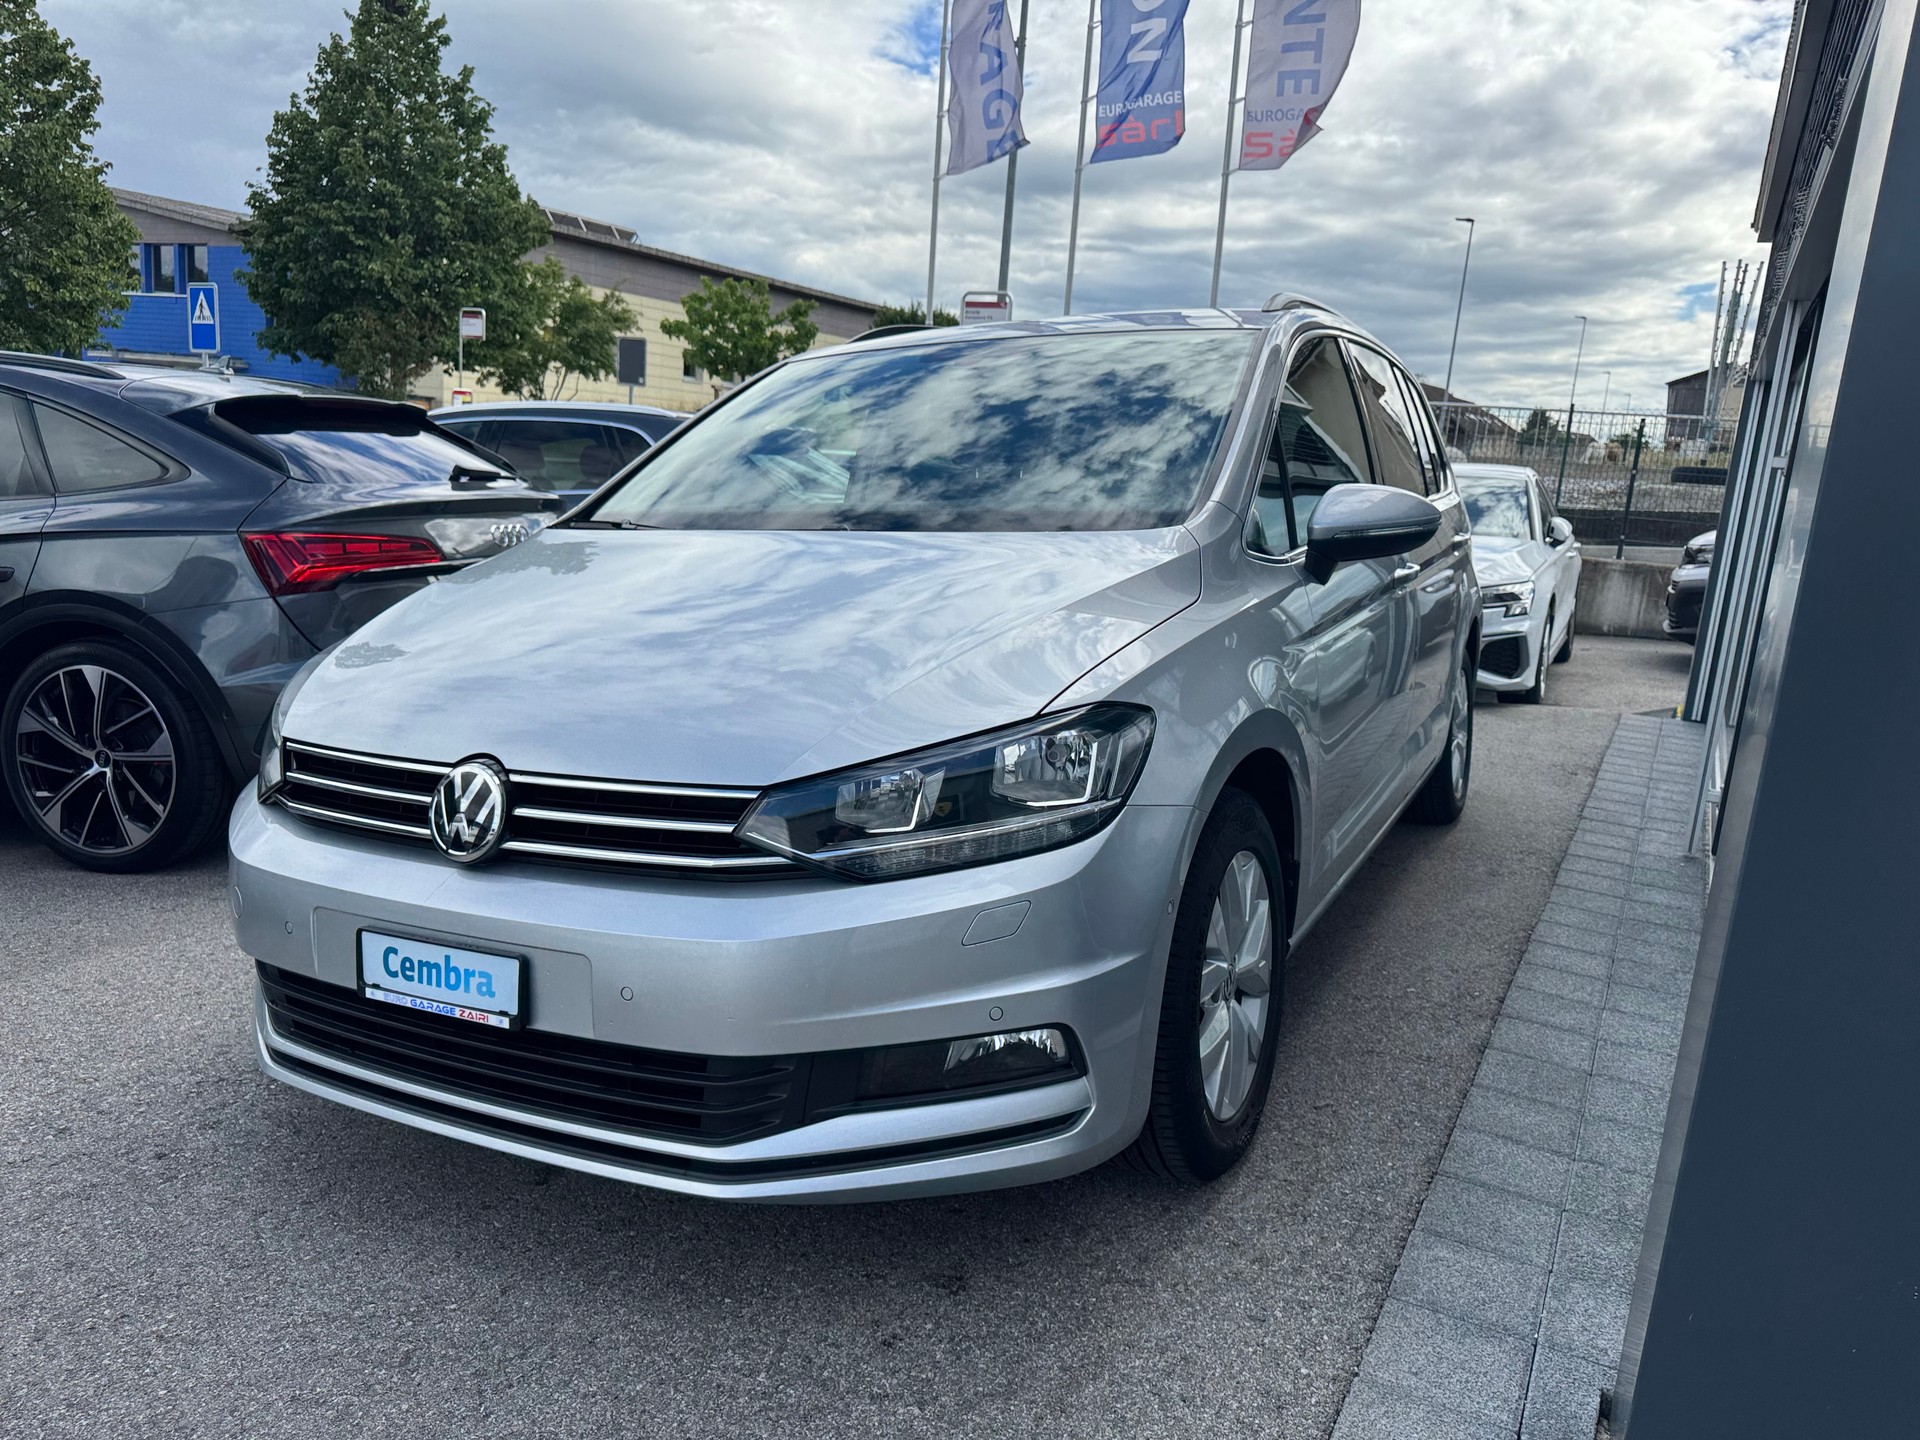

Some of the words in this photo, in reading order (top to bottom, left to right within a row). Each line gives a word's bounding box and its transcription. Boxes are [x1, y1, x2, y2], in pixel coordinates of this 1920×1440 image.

[383, 946, 496, 998] Cembra
[383, 992, 409, 1006] EURO
[410, 998, 456, 1016] GARAGE
[459, 1009, 489, 1024] ZAIRI
